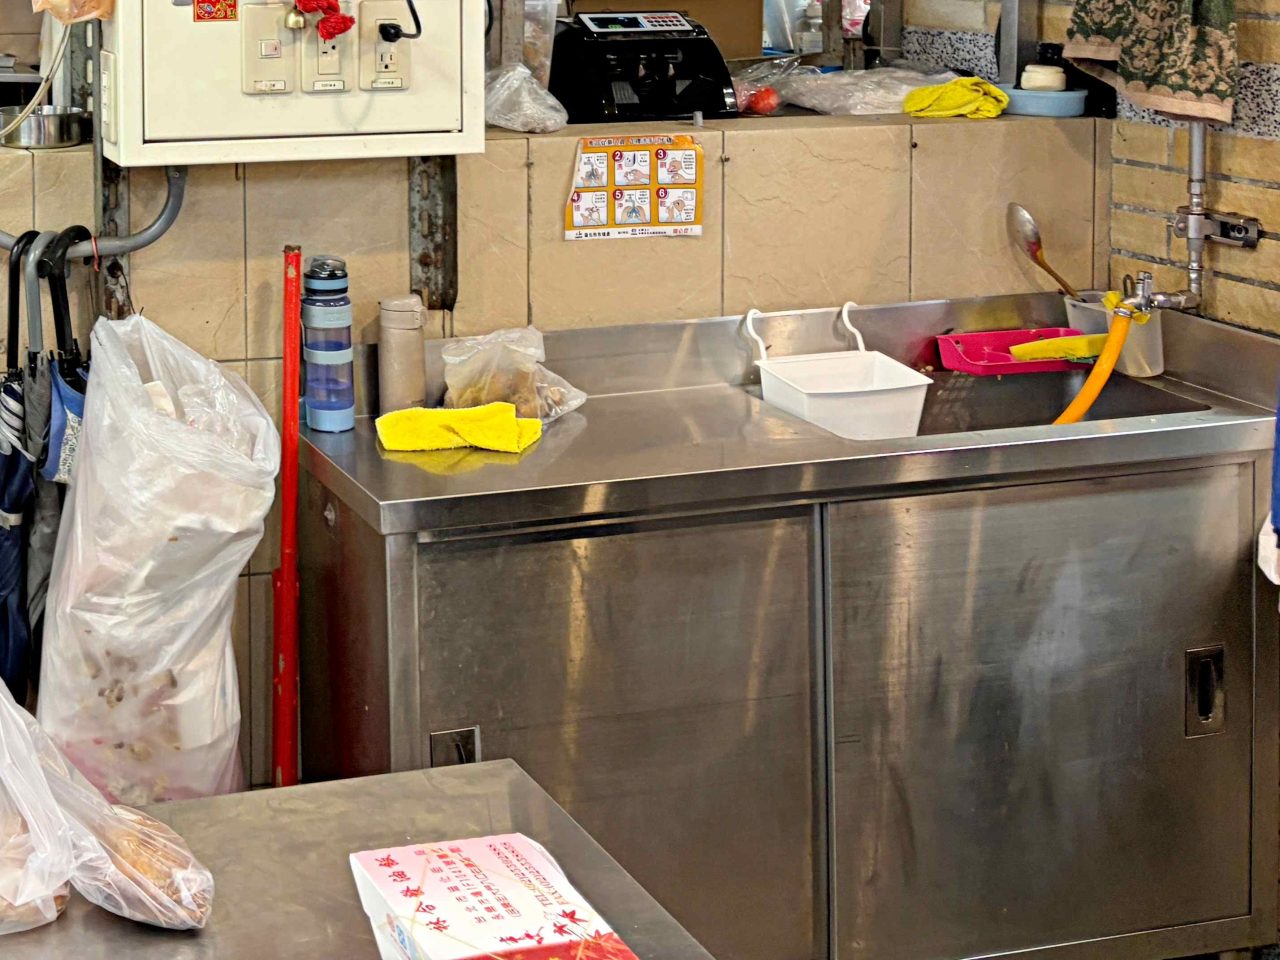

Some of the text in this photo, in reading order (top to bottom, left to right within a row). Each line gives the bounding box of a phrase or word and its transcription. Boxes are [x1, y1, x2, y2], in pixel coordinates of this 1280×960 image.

[615, 151, 621, 160] 2
[658, 150, 664, 159] 3
[615, 191, 621, 200] 5
[658, 189, 665, 197] 6
